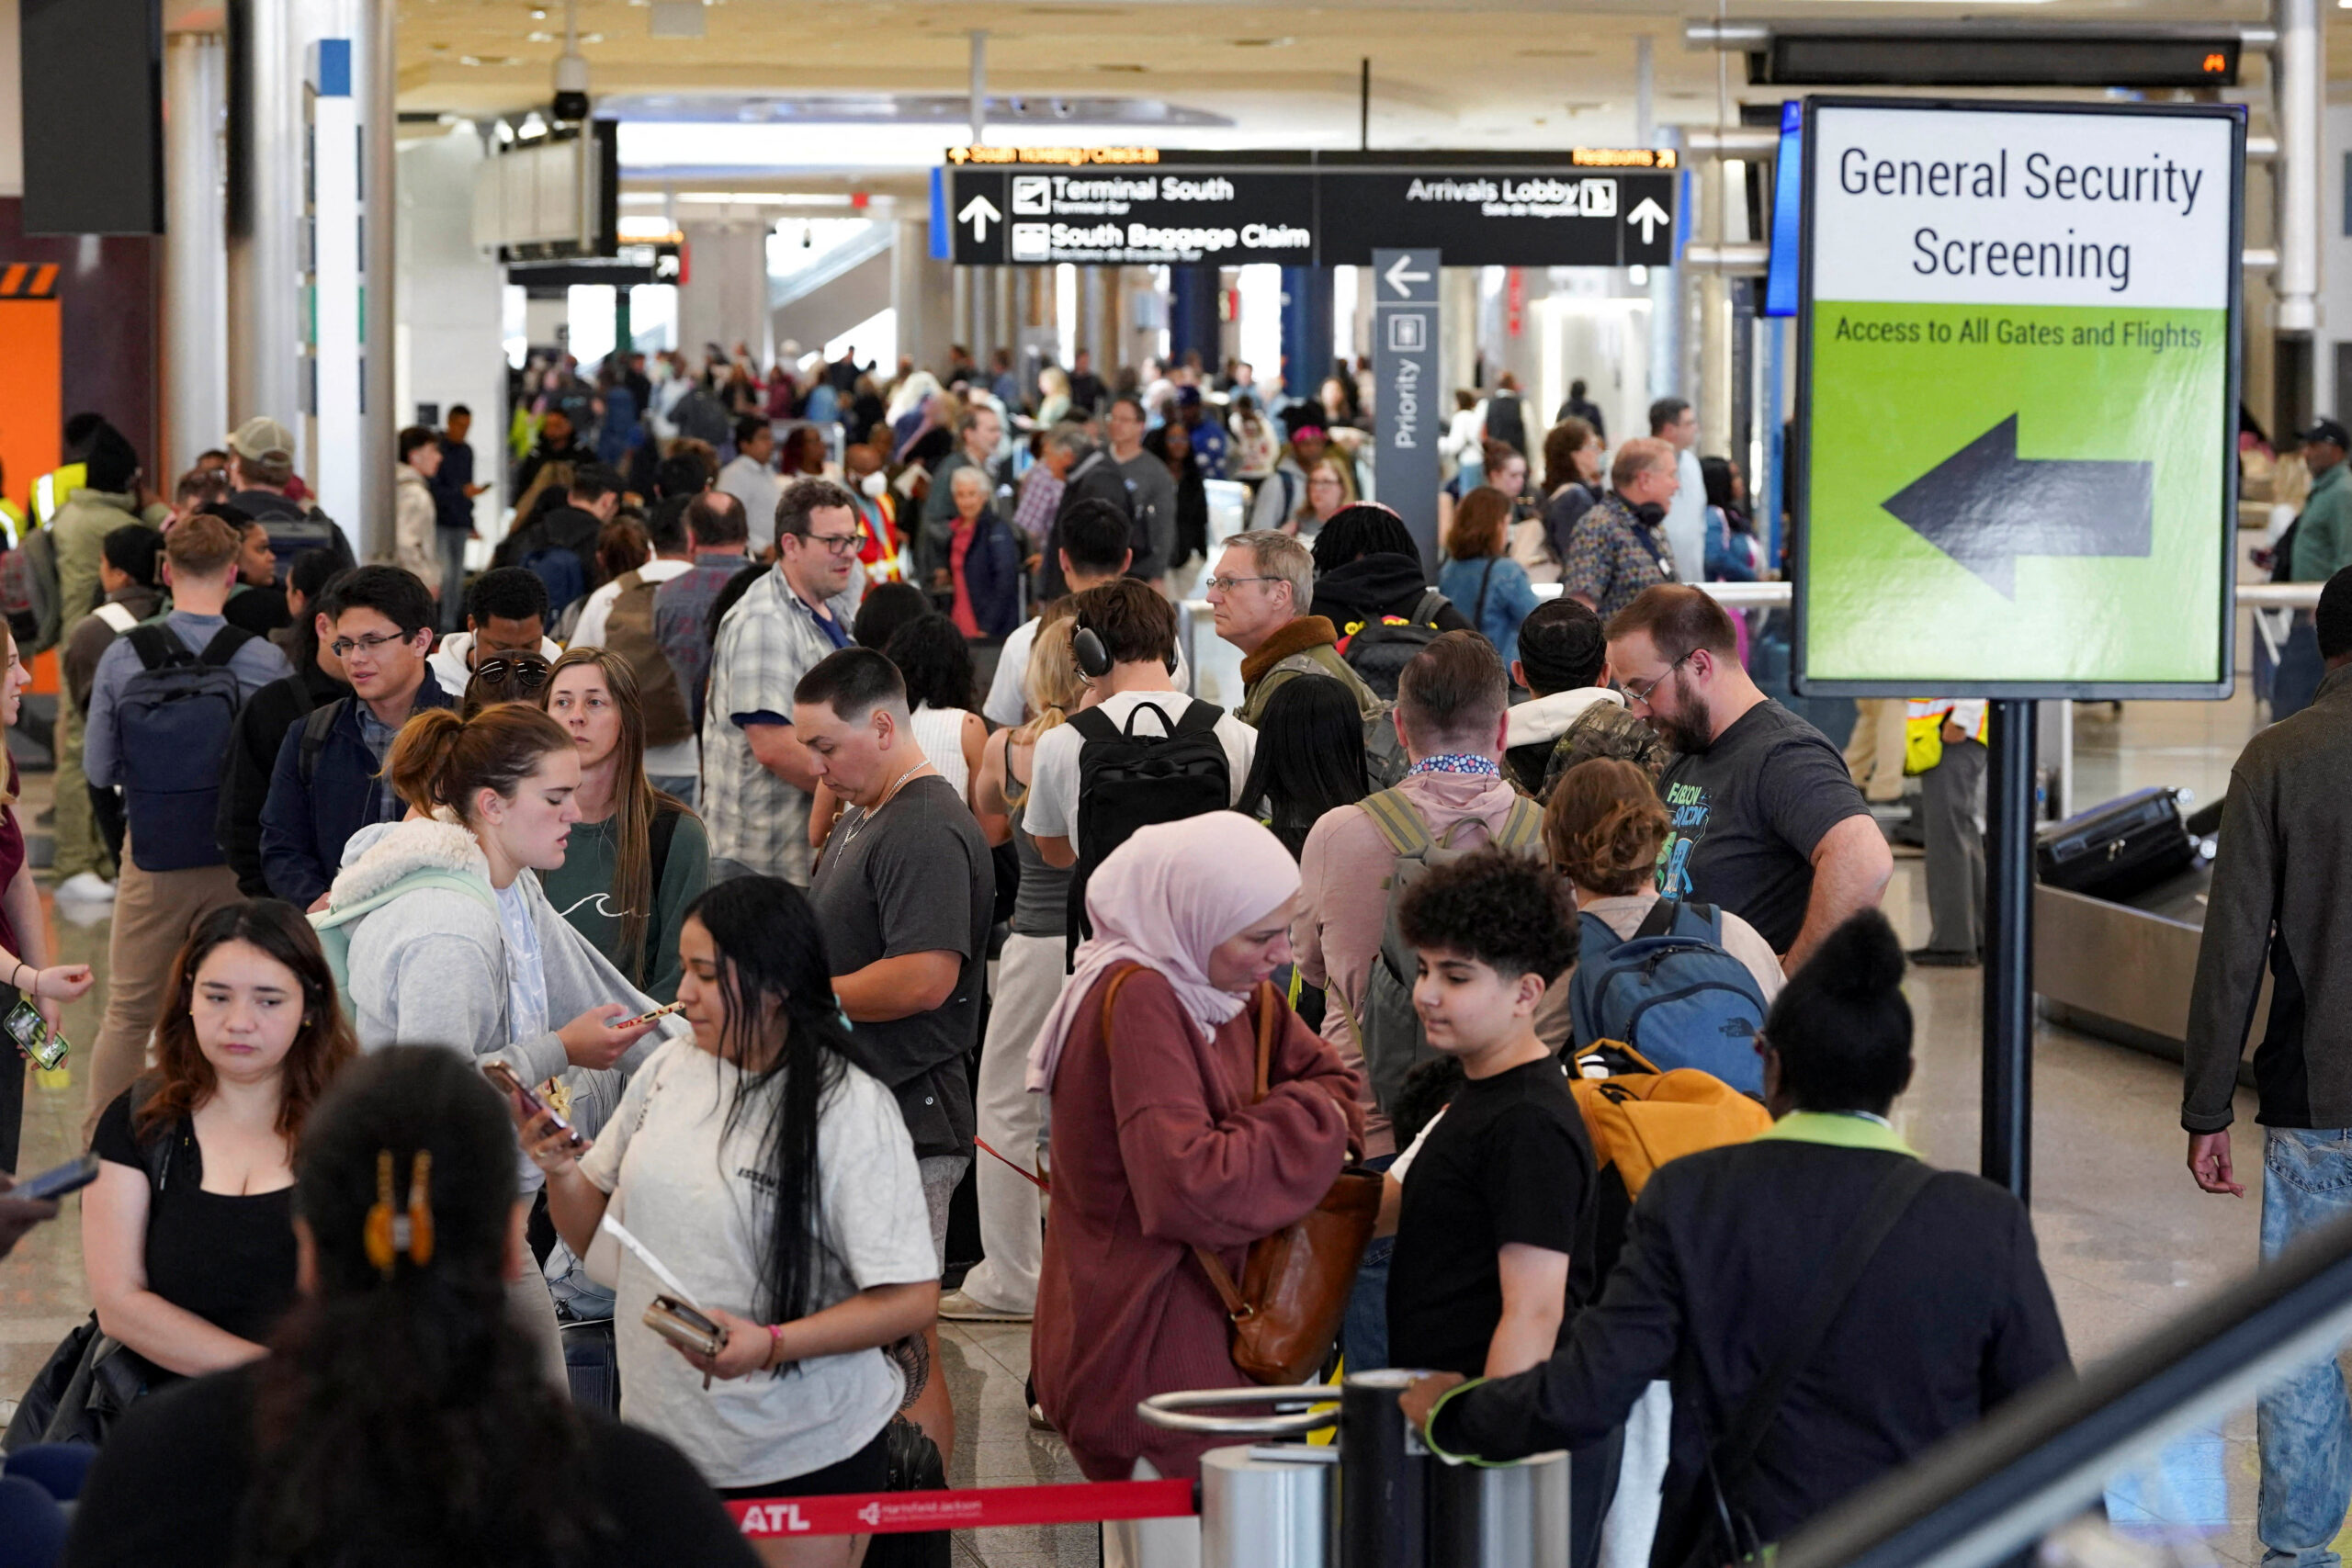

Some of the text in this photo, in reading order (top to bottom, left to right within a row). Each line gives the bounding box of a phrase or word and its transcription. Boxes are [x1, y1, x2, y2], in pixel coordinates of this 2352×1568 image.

[1051, 176, 1234, 201] Terminal South
[1406, 178, 1579, 205] Arrivals Lobby
[1840, 148, 2203, 216] General Security
[1051, 223, 1310, 252] South Baggage Claim
[1913, 228, 2131, 292] Screening
[1836, 316, 2202, 355] Access to All Gates and Flights
[1395, 358, 1421, 448] Priority
[740, 1504, 810, 1533] ATL
